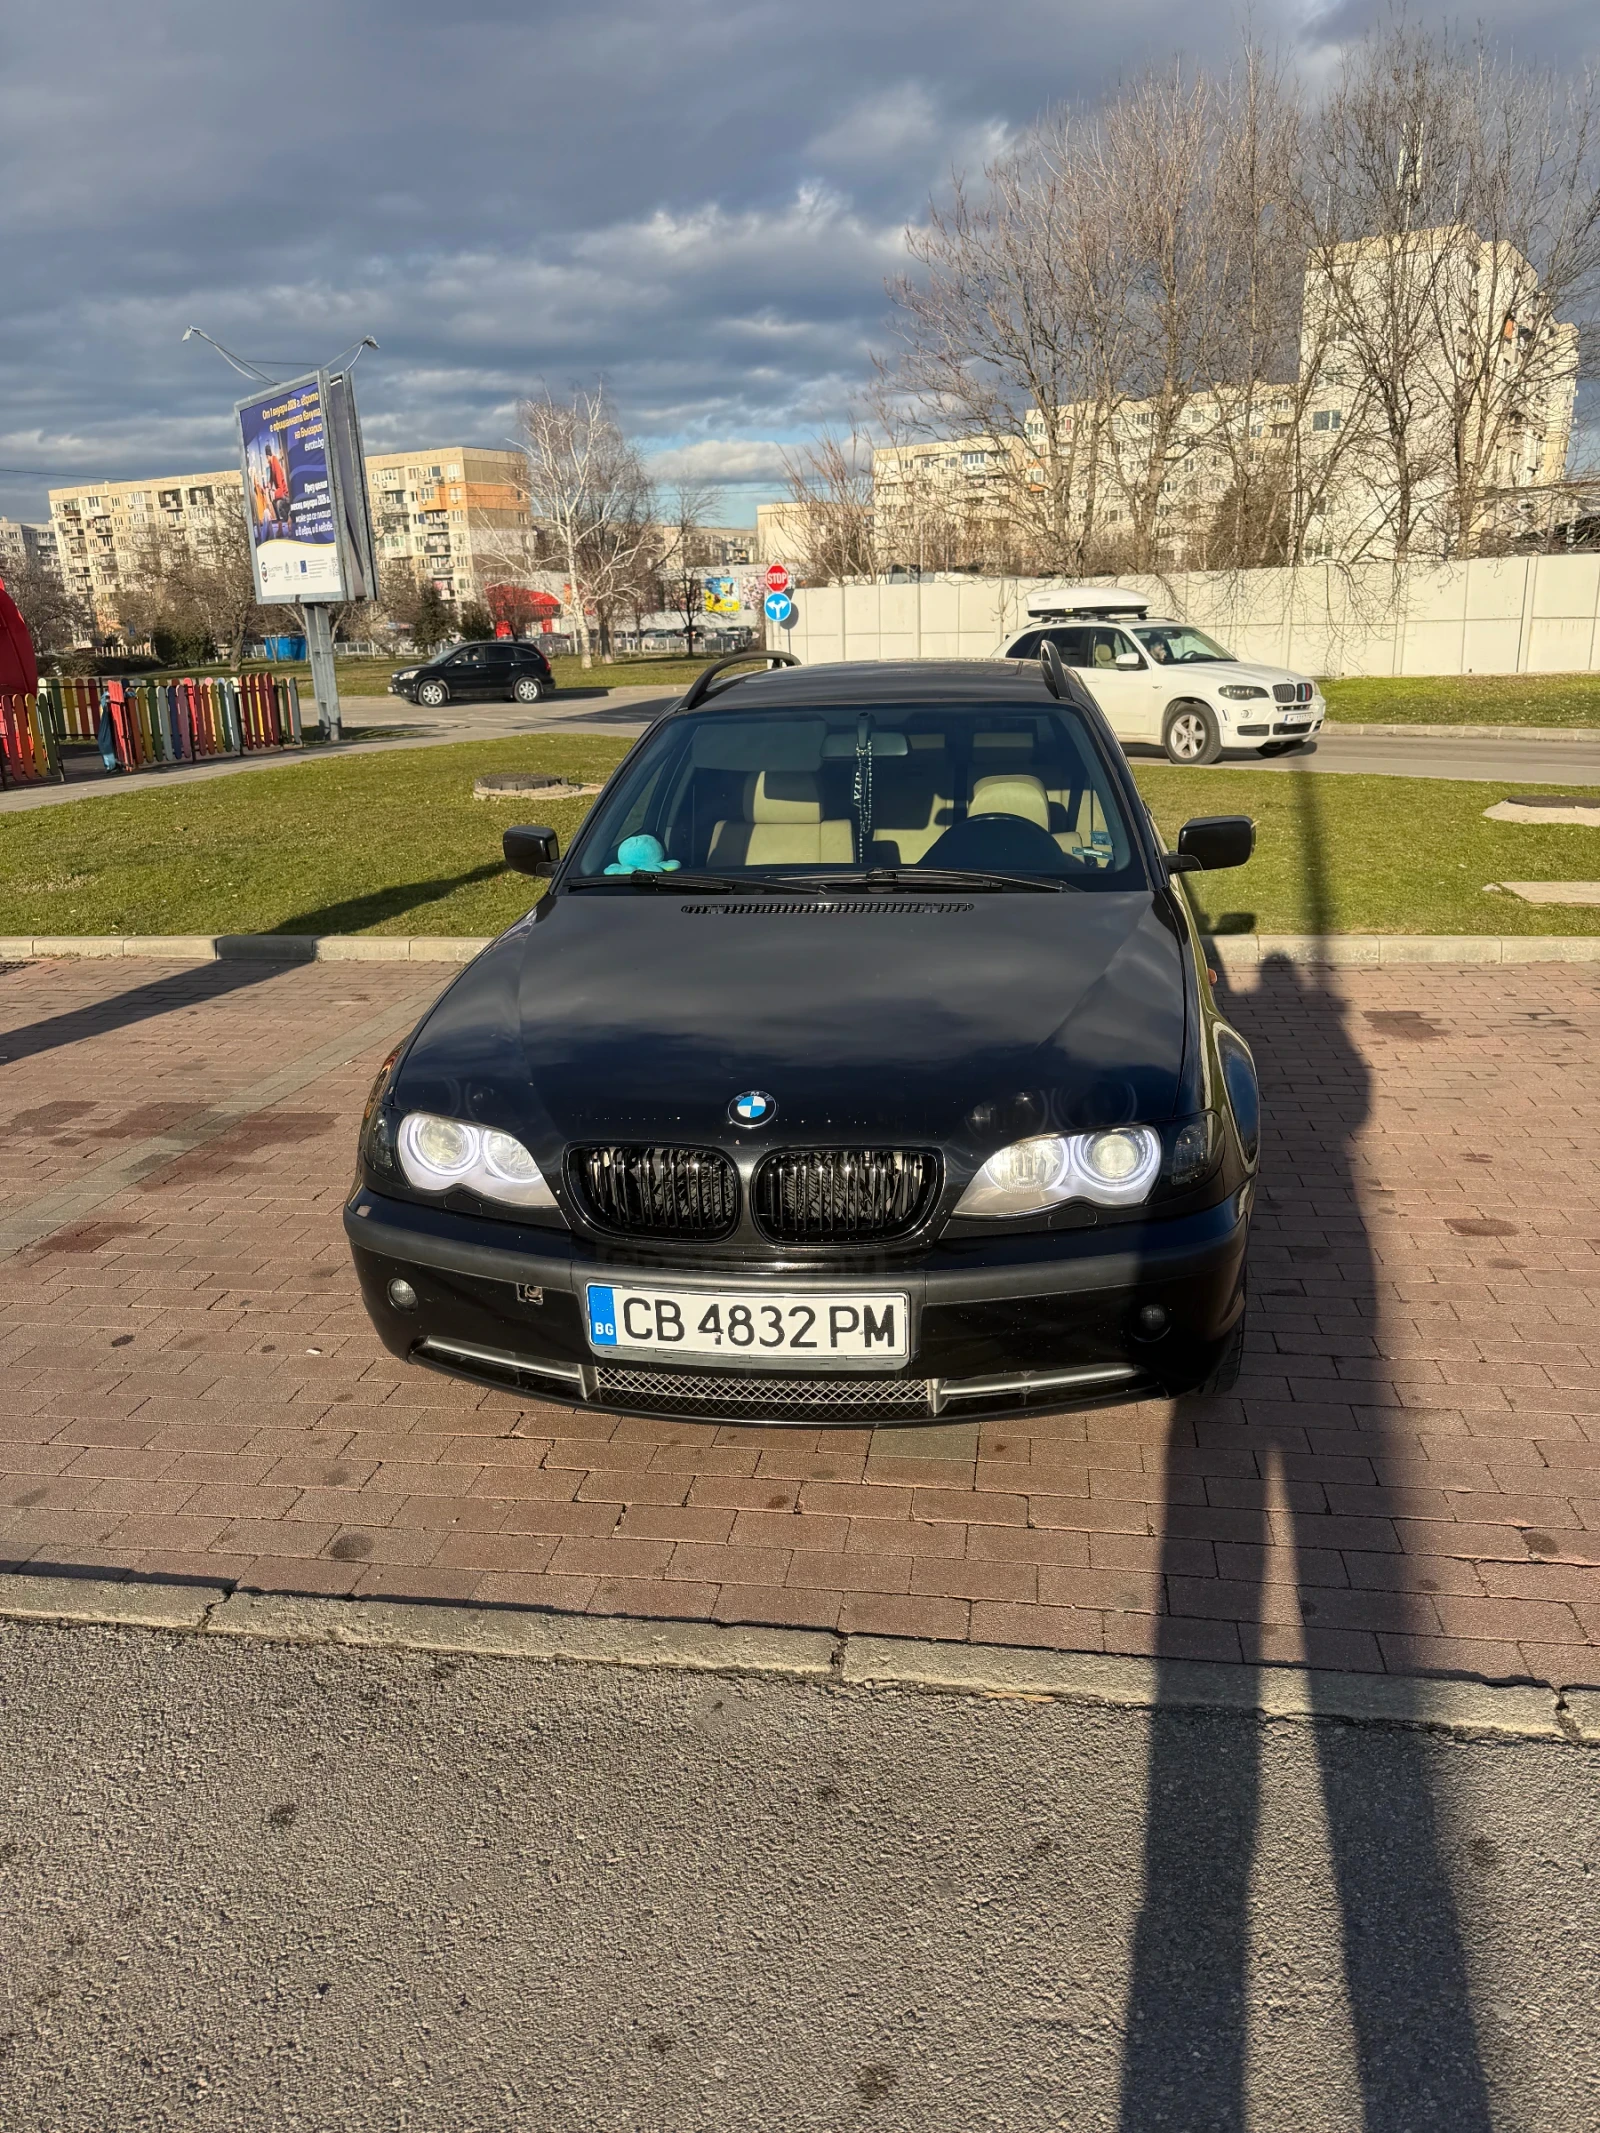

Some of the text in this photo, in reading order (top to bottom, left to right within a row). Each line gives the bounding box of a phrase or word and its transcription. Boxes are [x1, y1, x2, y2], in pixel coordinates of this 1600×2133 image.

[767, 572, 787, 585] STOP
[594, 1321, 615, 1337] BG
[622, 1296, 896, 1348] CB 4832 PM
